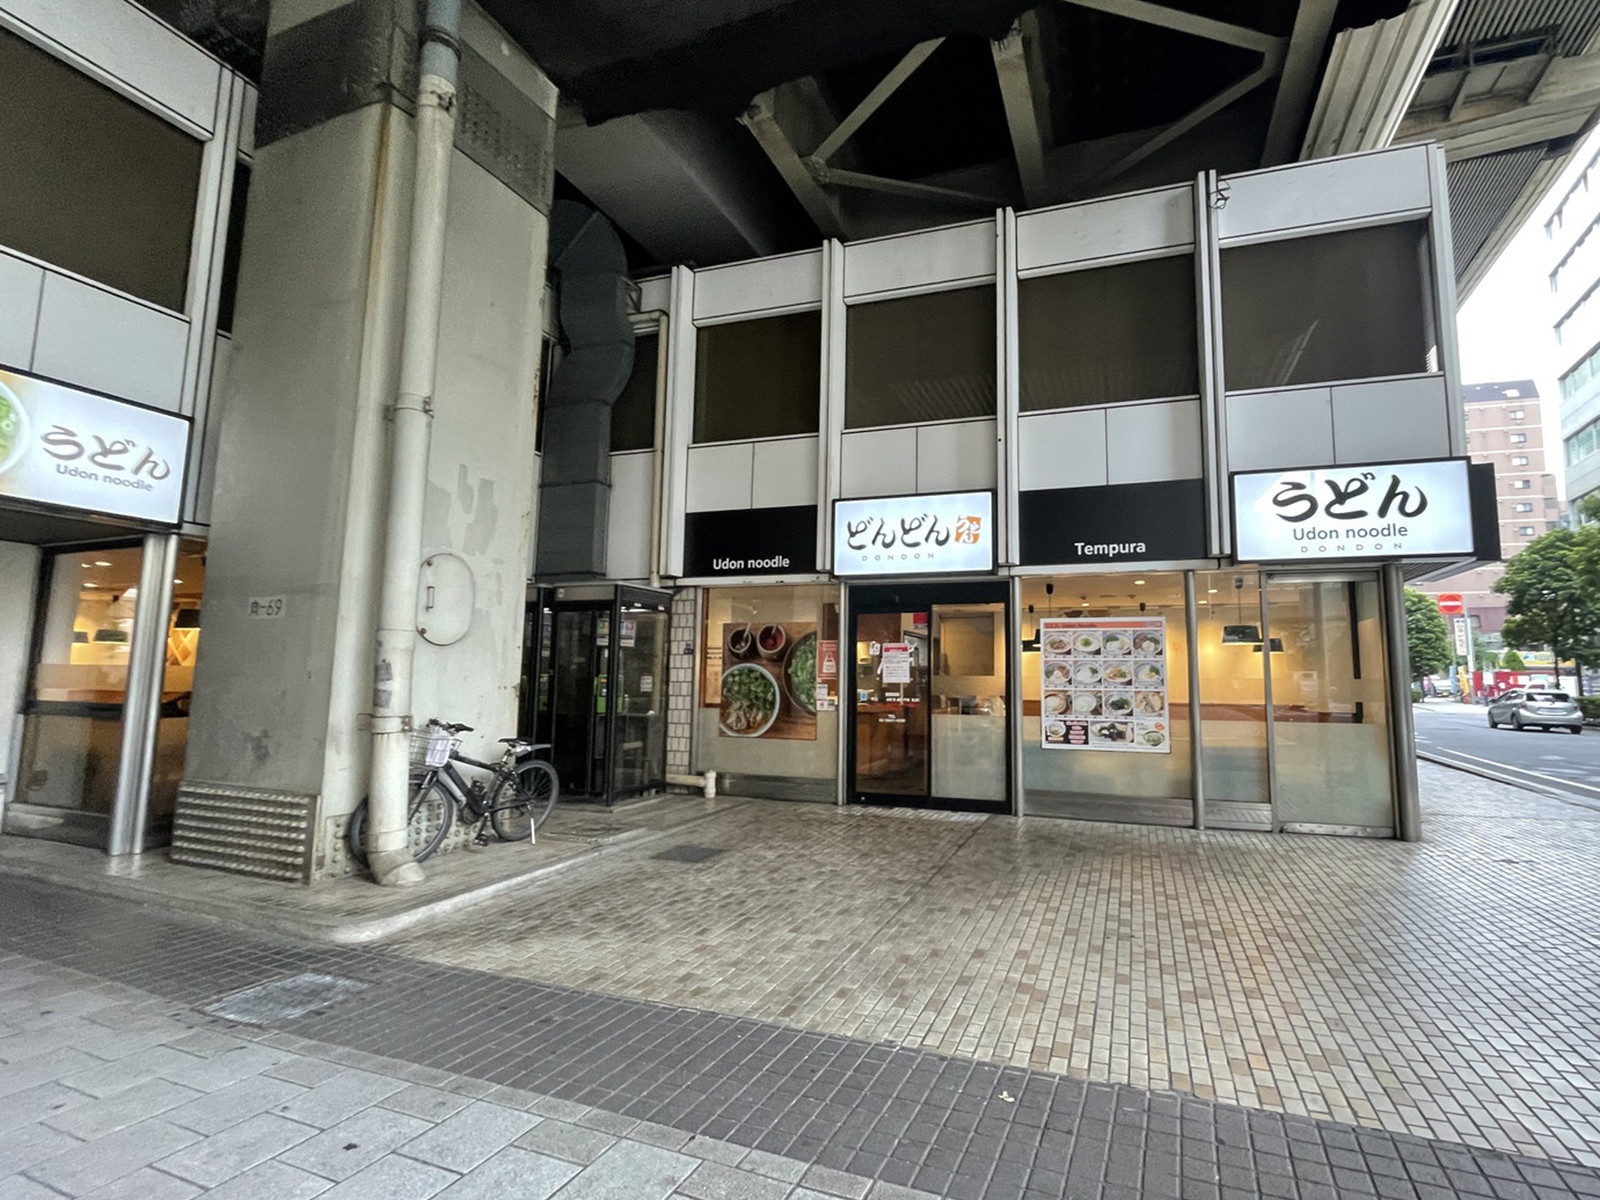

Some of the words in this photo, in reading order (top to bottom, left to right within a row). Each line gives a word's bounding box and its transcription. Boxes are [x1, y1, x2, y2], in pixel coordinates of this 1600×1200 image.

[40, 424, 171, 481] うどん
[56, 463, 99, 481] Udon
[103, 475, 154, 492] noodle
[1272, 472, 1428, 523] うどん
[847, 513, 951, 551] どんどん
[1293, 527, 1339, 541] Udon
[1346, 523, 1409, 539] noodle
[713, 558, 745, 570] Udon
[747, 555, 790, 569] noodle
[1074, 542, 1147, 558] Tempura
